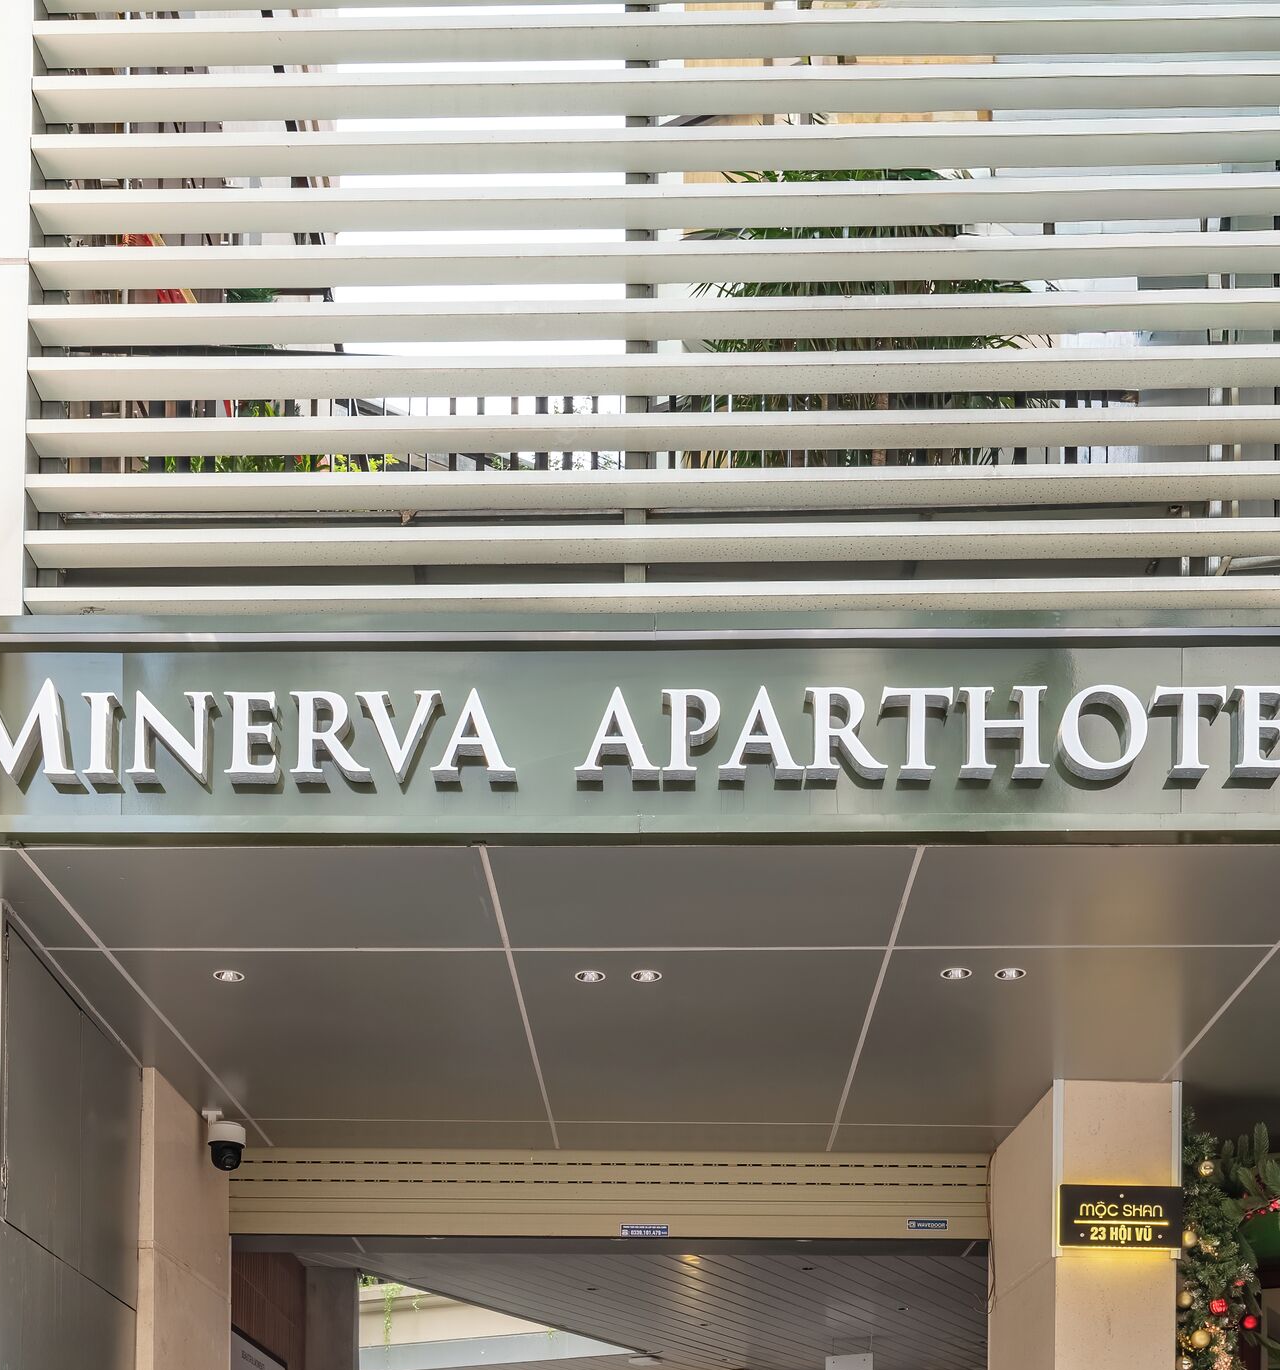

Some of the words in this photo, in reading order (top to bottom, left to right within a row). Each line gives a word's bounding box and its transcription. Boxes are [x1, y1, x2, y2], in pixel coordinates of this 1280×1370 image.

[1079, 1200, 1119, 1219] MỘC
[1122, 1204, 1164, 1217] SHAN
[1089, 1226, 1107, 1241] 23
[1109, 1224, 1132, 1244] HỘI
[1135, 1225, 1153, 1241] VŨ
